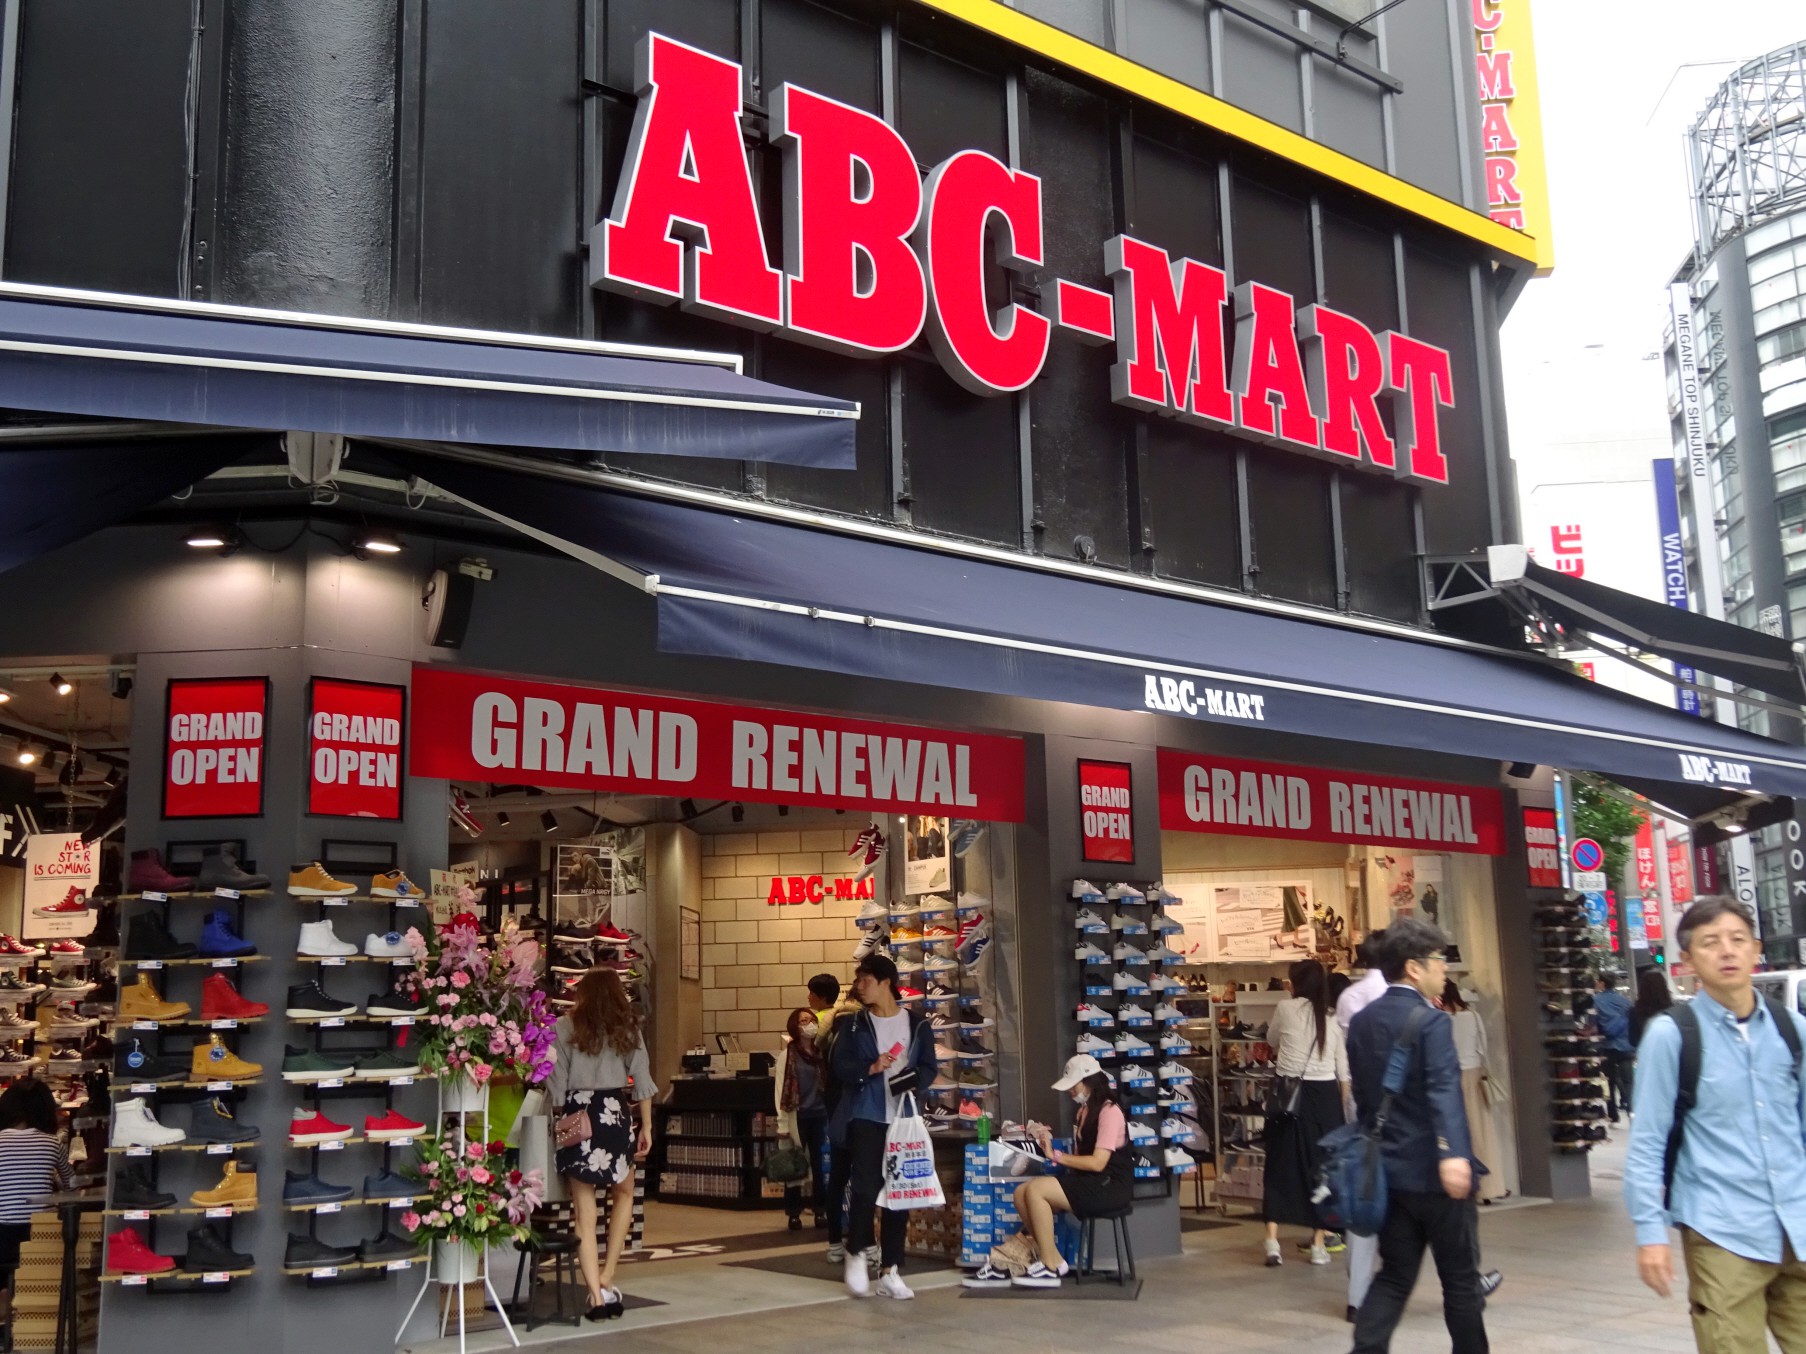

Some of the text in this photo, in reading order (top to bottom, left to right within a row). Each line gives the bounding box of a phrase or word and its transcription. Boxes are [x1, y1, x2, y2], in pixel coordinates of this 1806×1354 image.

[603, 30, 1456, 485] ABC-MART
[1677, 313, 1706, 477] MEGANE TOP SHINJUKU
[1144, 675, 1265, 722] ABC-MART
[170, 711, 263, 743] GRAND
[313, 711, 400, 746] GRAND
[471, 691, 978, 808] GRAND RENEWAL
[170, 747, 260, 786] OPEN
[314, 747, 398, 788] OPEN
[1678, 753, 1752, 785] ABC-MART
[1081, 783, 1131, 809] GRAND
[1183, 764, 1479, 845] GRAND RENEWAL
[1083, 811, 1131, 840] OPEN
[1525, 825, 1558, 846] GRAND
[34, 863, 91, 875] IS COMING
[1527, 847, 1559, 870] OPEN
[767, 875, 875, 905] ABC-MA
